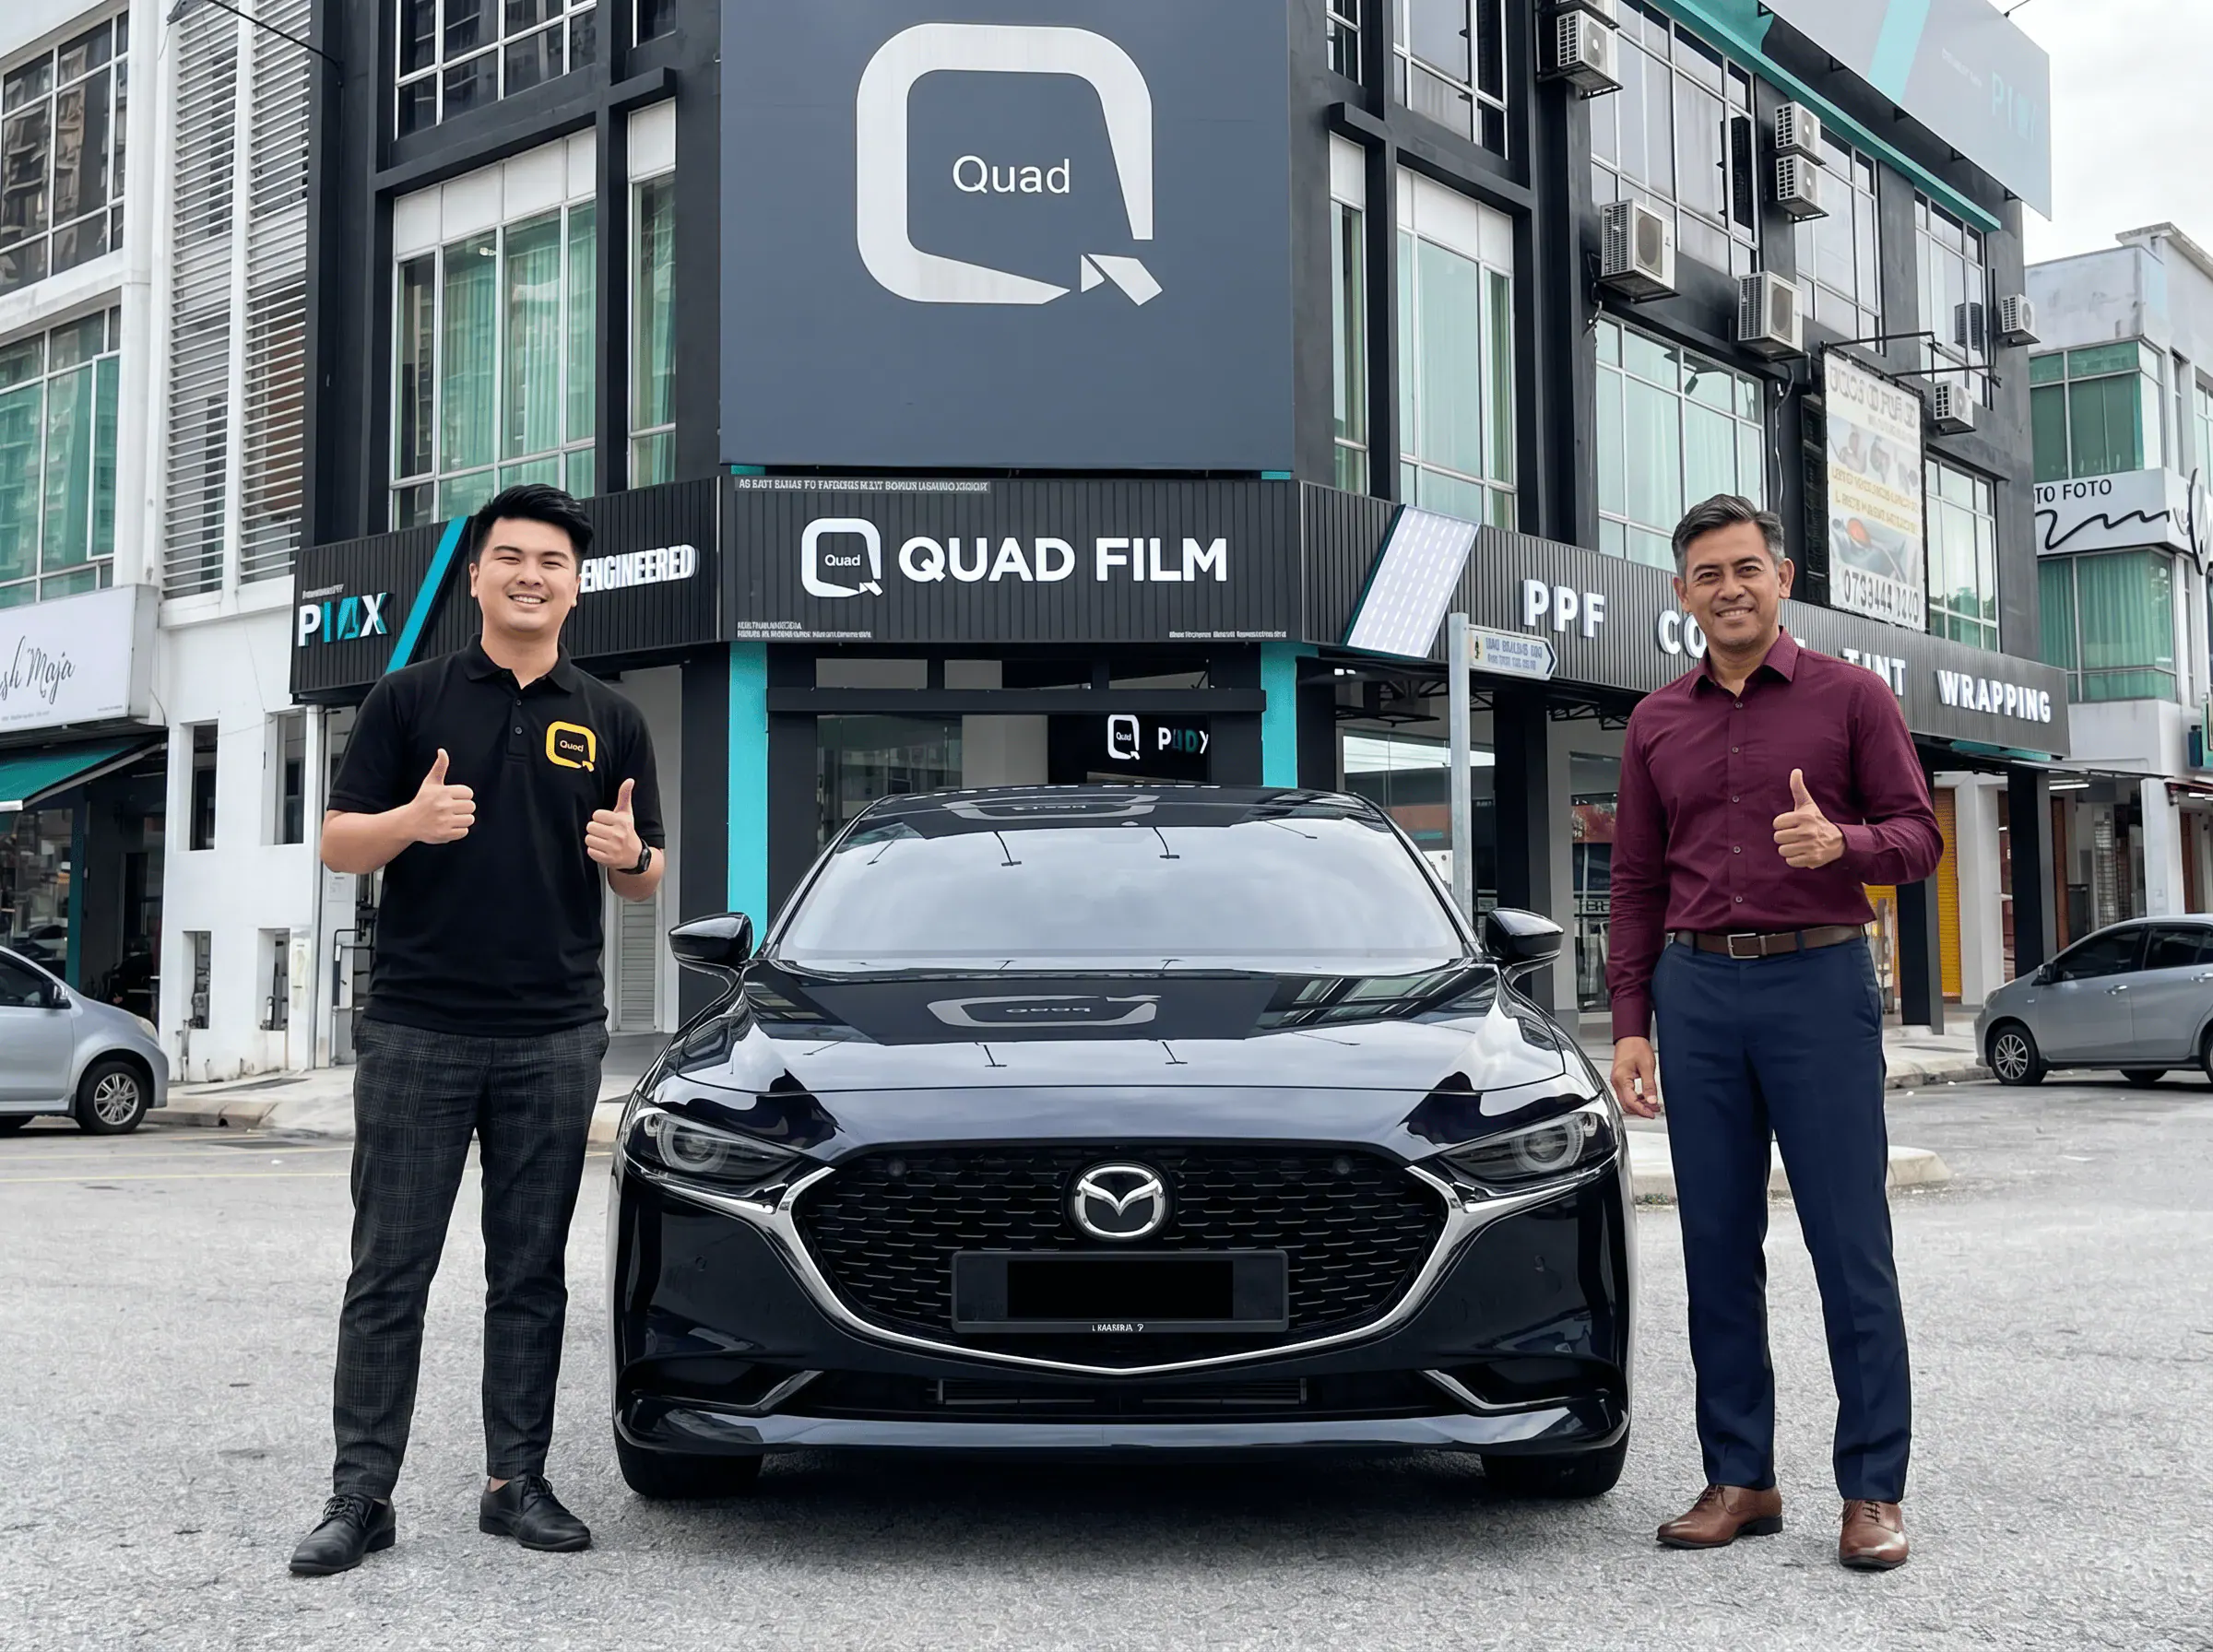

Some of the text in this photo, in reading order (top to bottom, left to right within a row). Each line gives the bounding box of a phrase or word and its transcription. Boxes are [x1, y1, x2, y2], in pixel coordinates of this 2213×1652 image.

[952, 155, 1071, 194] Quad
[2063, 478, 2112, 500] FOTO
[579, 544, 697, 594] ENGINEERED
[824, 554, 861, 568] Quad
[898, 536, 1227, 583] QUAD FILM
[1522, 579, 1605, 638] PPF
[1936, 669, 2052, 724] WRAPPING
